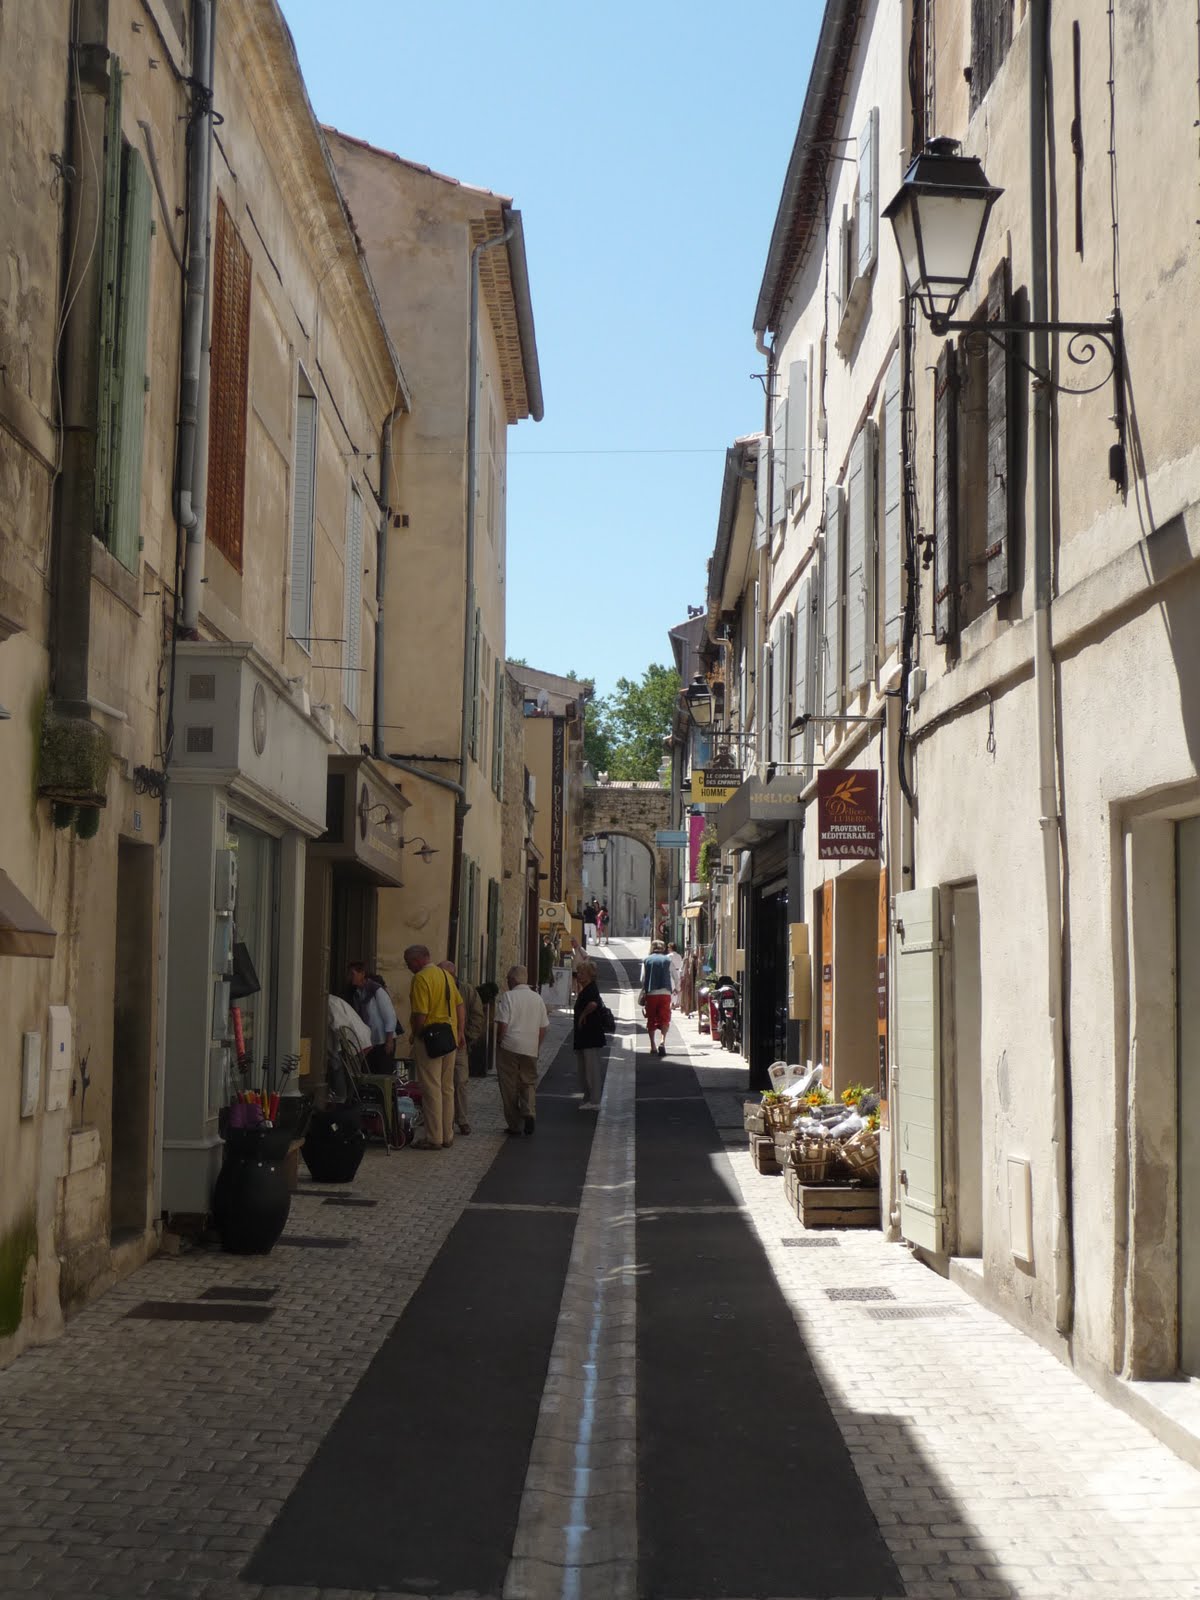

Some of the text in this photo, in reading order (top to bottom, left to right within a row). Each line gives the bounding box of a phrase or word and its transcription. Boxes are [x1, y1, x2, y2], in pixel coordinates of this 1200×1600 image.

[701, 788, 727, 797] HOMME
[833, 815, 873, 823] LUBERON
[821, 831, 876, 840] MÉDITERRANÉE
[821, 845, 877, 858] MAGASIN
